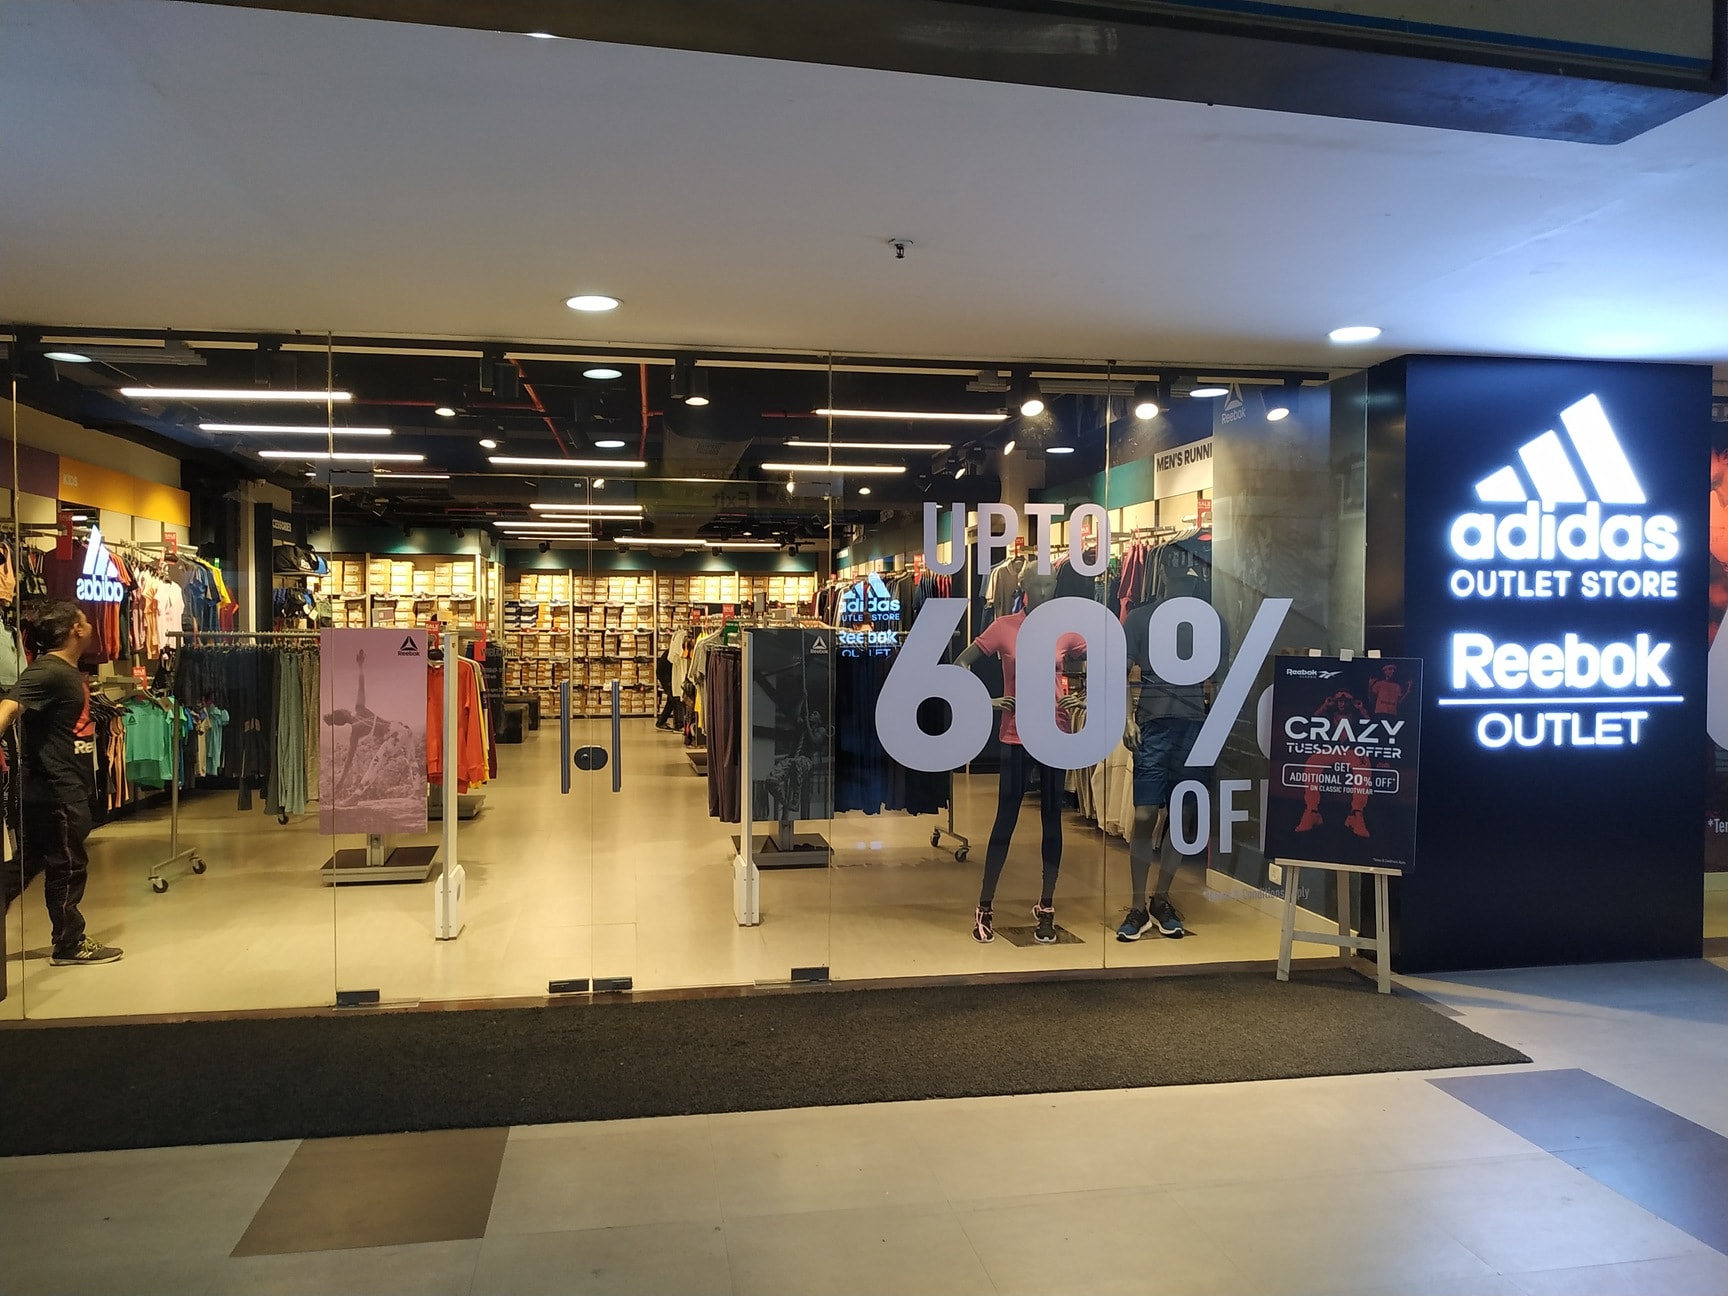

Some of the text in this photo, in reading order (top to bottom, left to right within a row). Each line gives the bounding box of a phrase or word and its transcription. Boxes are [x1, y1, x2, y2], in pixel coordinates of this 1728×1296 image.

[1221, 407, 1246, 425] Reebok
[1156, 452, 1183, 472] MEN'S
[1449, 500, 1680, 562] adidas
[1450, 569, 1678, 598] OUTLET STORE
[871, 613, 901, 621] STORE
[1453, 632, 1672, 689] Reebok
[1286, 668, 1318, 676] Reebok
[1284, 716, 1405, 745] CRAZY
[1477, 711, 1649, 748] OUTLET
[1286, 742, 1402, 759] TUESDAY OFFER
[1334, 762, 1351, 773] GET
[1289, 772, 1342, 785] ADDITIONAL
[1344, 774, 1373, 787] 20%
[1310, 784, 1374, 795] ON CLASSIC FOOTWEAR
